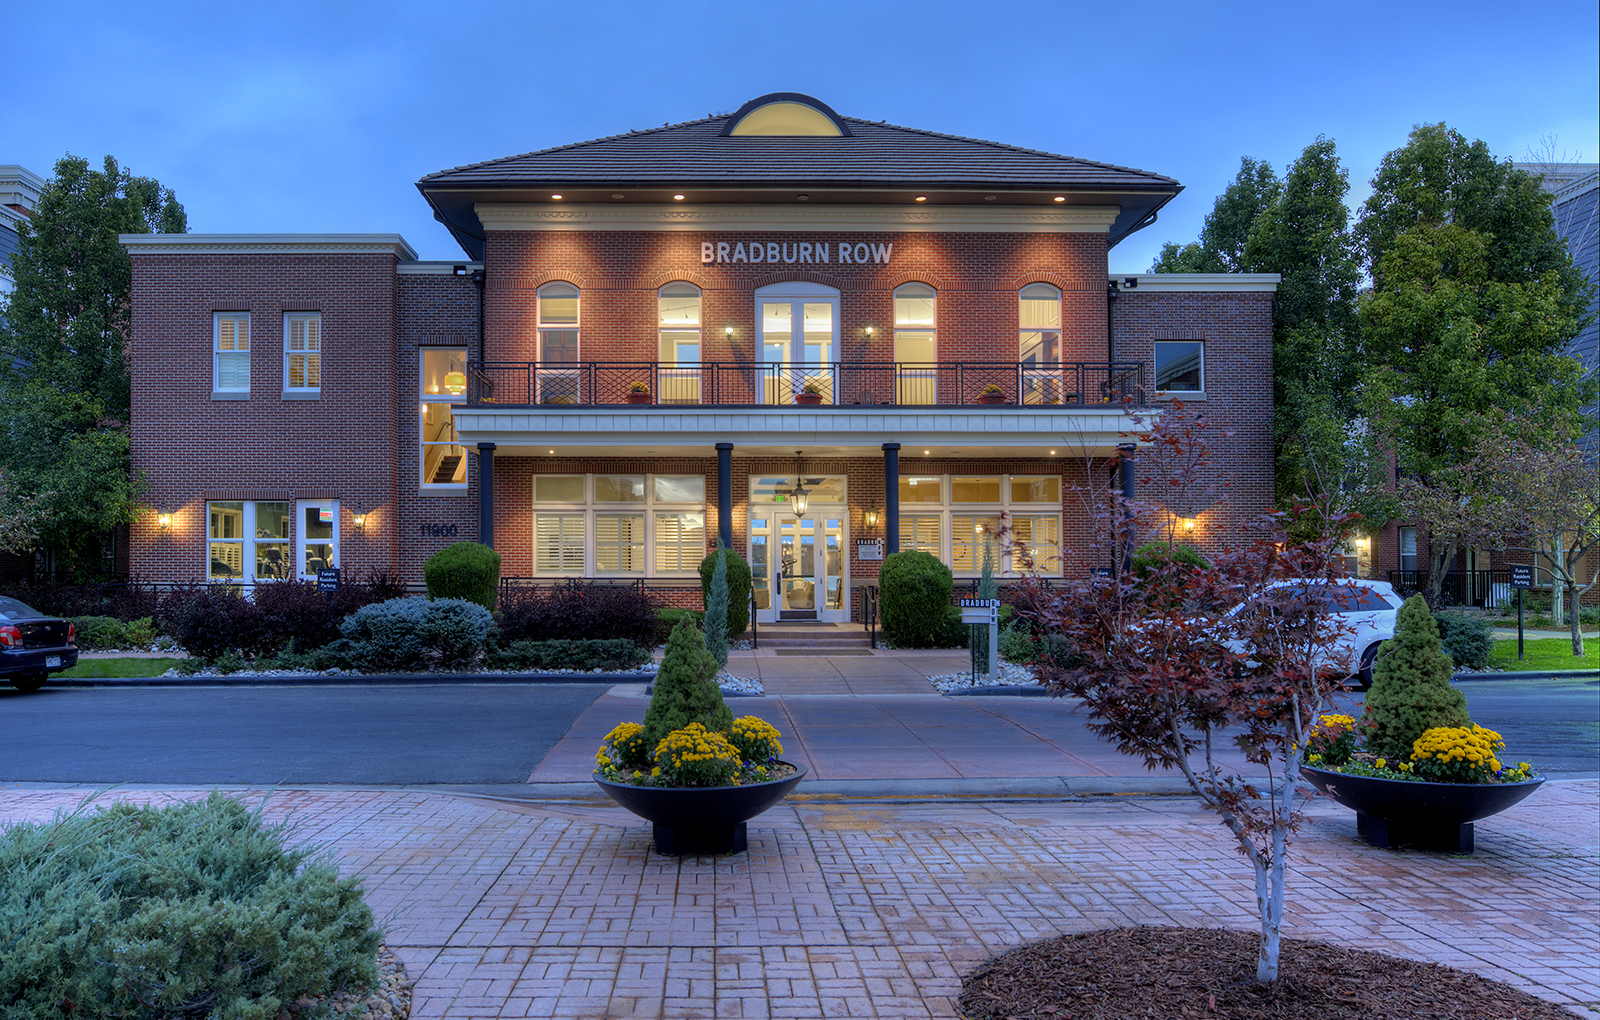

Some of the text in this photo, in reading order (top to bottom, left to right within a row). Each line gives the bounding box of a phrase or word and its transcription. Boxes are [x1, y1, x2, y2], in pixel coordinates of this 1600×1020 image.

[701, 242, 893, 264] BRADBURN ROW
[420, 524, 457, 537] 11900
[960, 599, 1001, 607] BRADBURN
